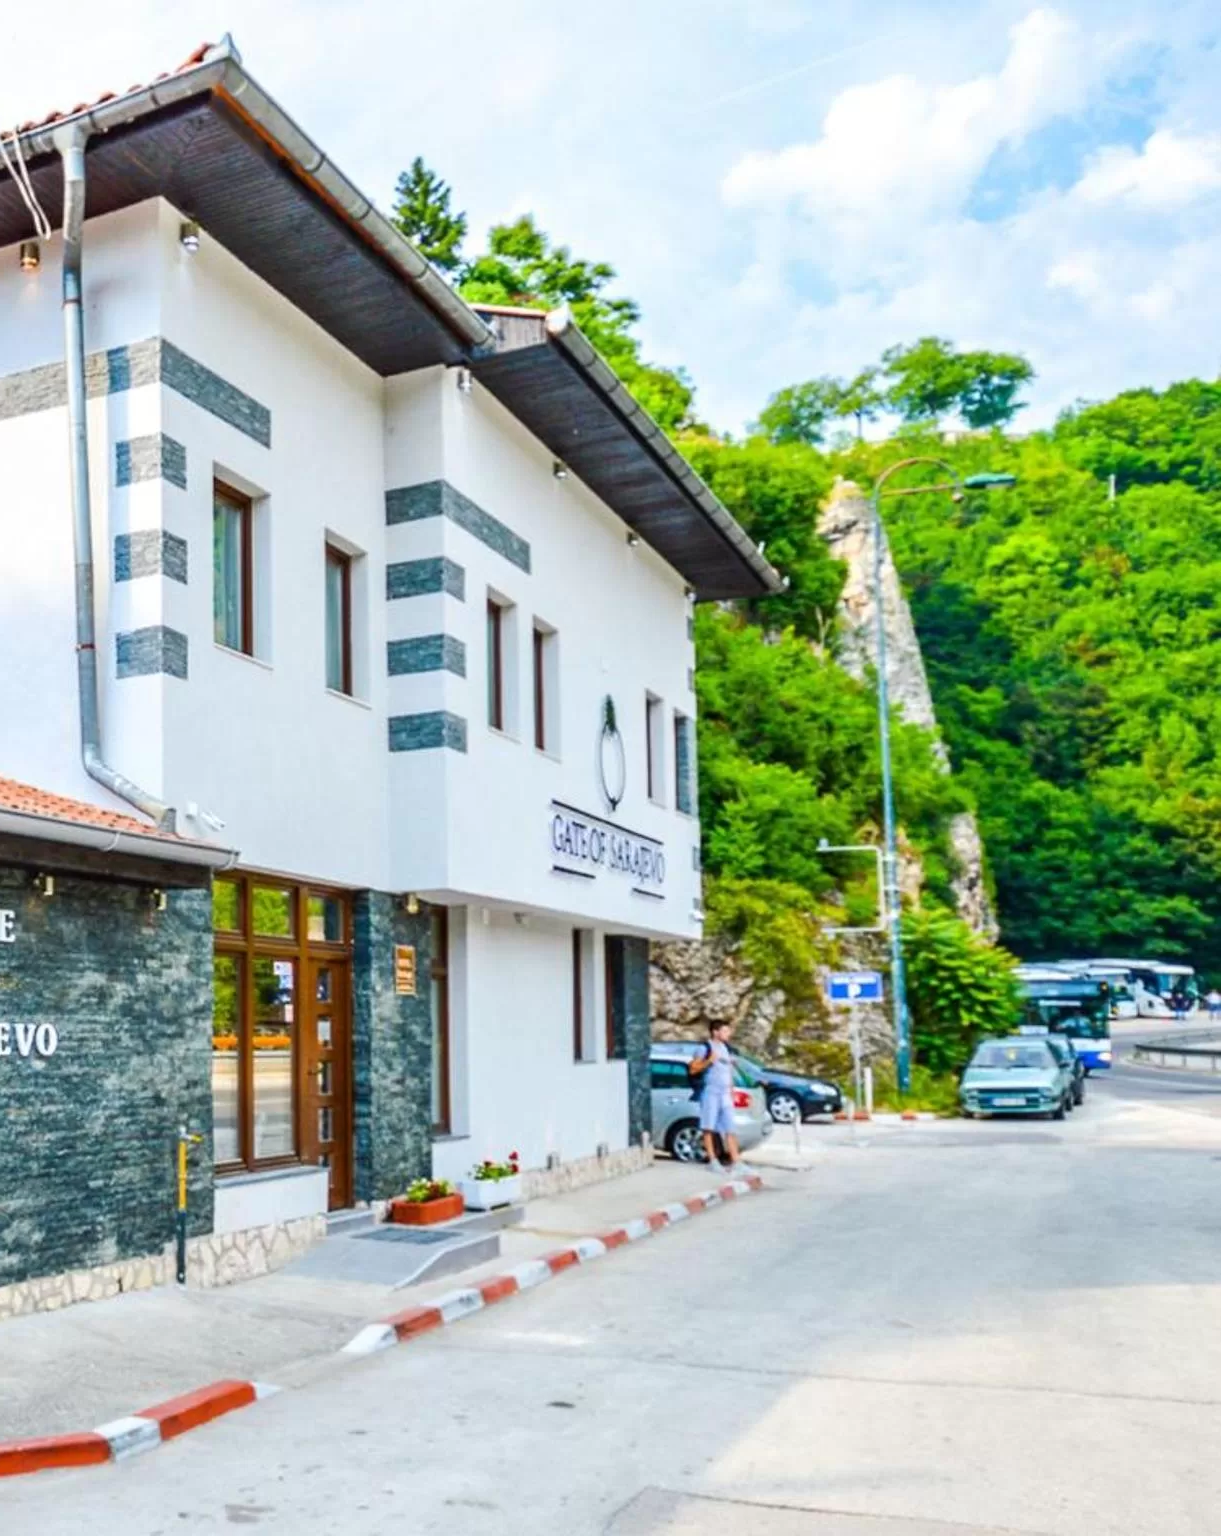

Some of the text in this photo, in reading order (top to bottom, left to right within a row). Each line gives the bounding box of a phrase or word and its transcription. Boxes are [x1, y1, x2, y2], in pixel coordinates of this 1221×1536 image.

[552, 814, 665, 884] GATE OF SARAJEVO
